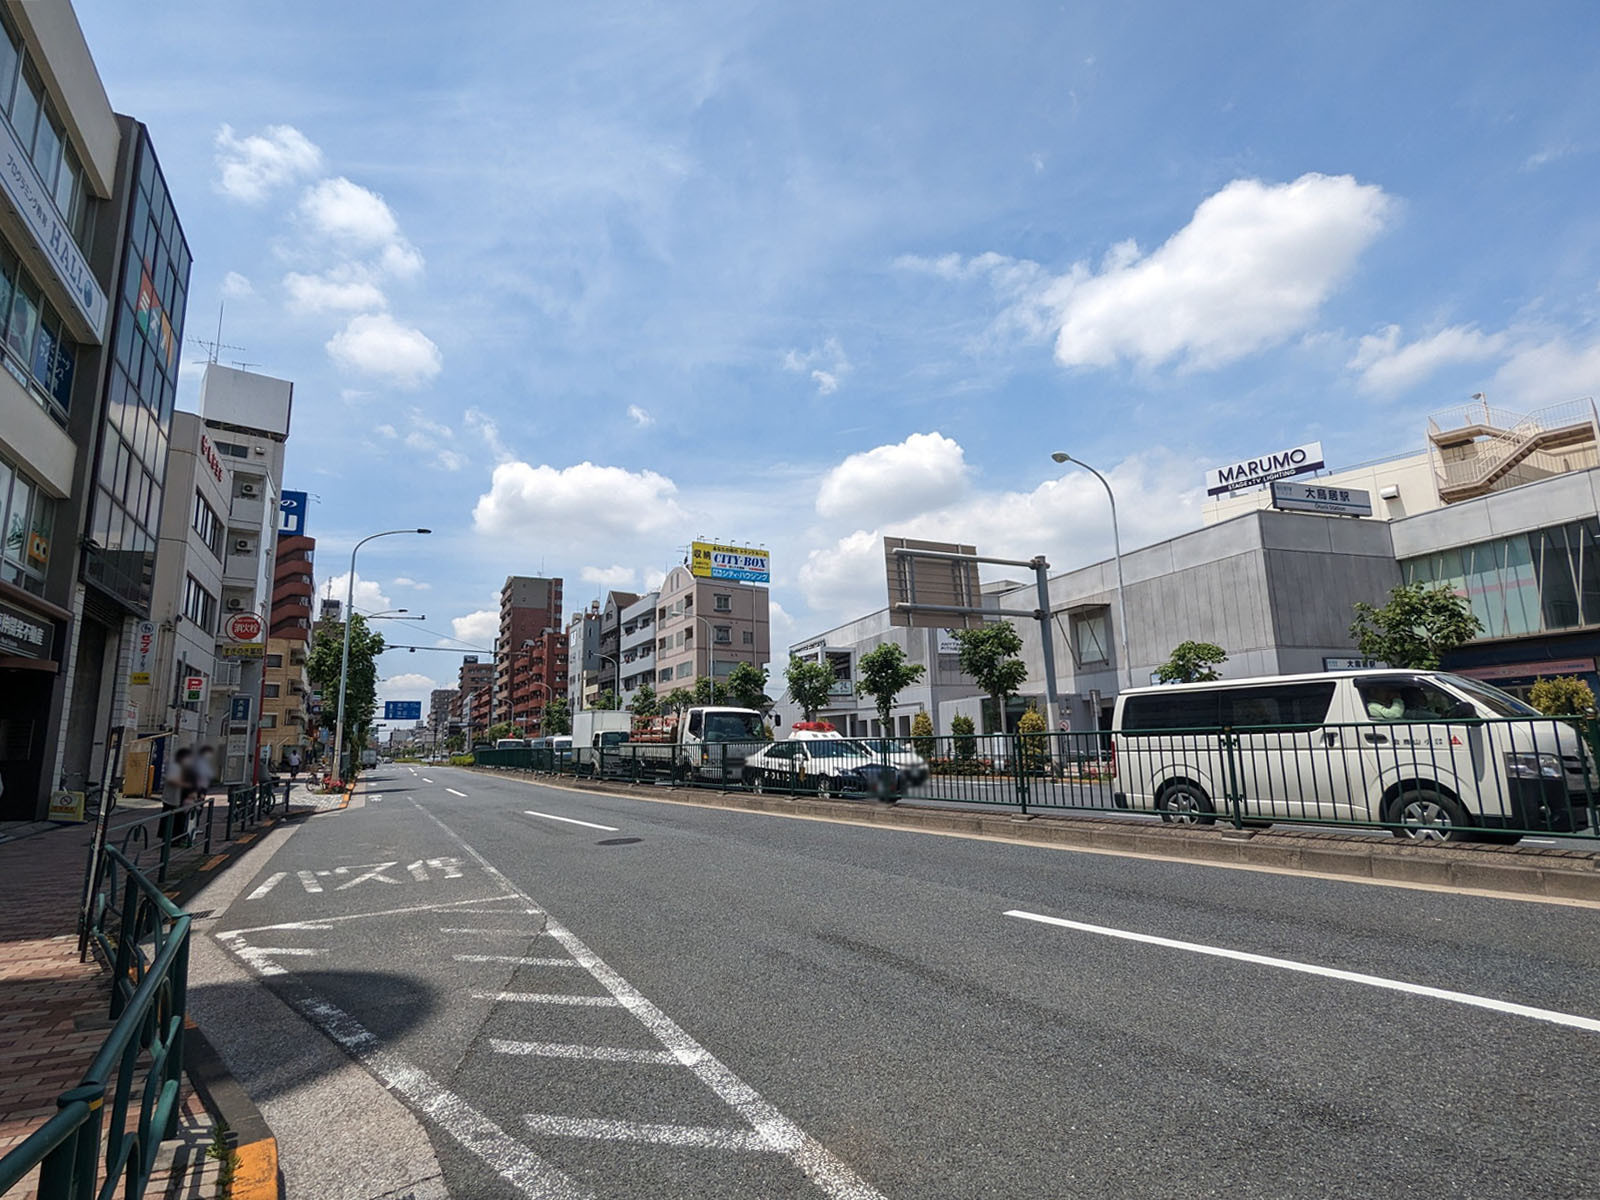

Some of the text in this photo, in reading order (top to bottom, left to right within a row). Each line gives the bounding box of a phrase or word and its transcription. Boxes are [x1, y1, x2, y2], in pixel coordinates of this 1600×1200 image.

[1218, 449, 1306, 484] MARUMO
[1304, 487, 1351, 502] 大鳥居駅
[234, 622, 259, 633] 消火栓
